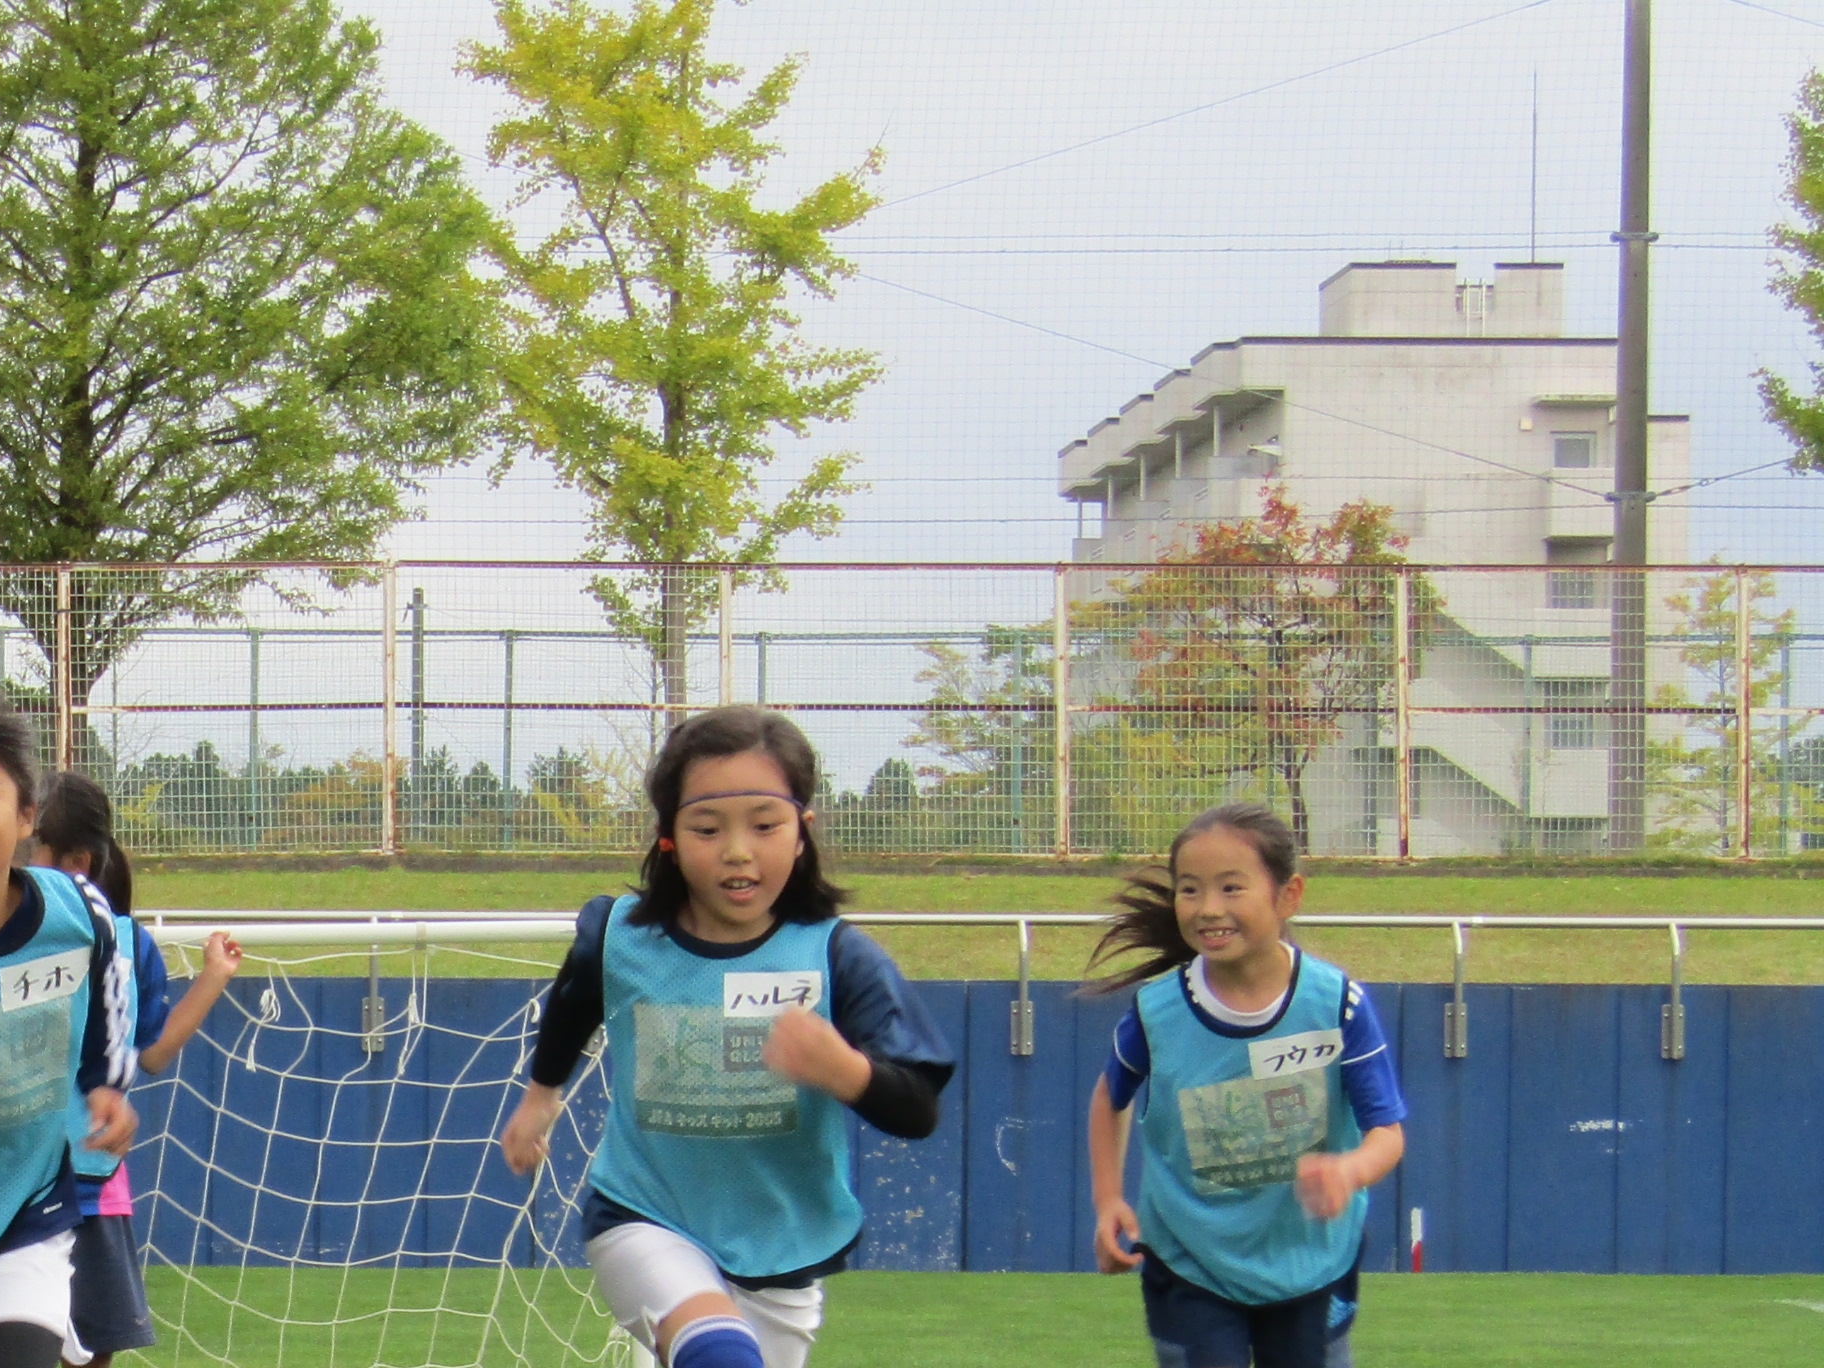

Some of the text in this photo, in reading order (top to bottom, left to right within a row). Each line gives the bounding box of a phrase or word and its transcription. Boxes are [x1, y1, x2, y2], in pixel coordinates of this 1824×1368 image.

[12, 964, 76, 1002] チホ
[729, 978, 814, 1010] ハルネ
[1262, 1043, 1337, 1073] フウカ
